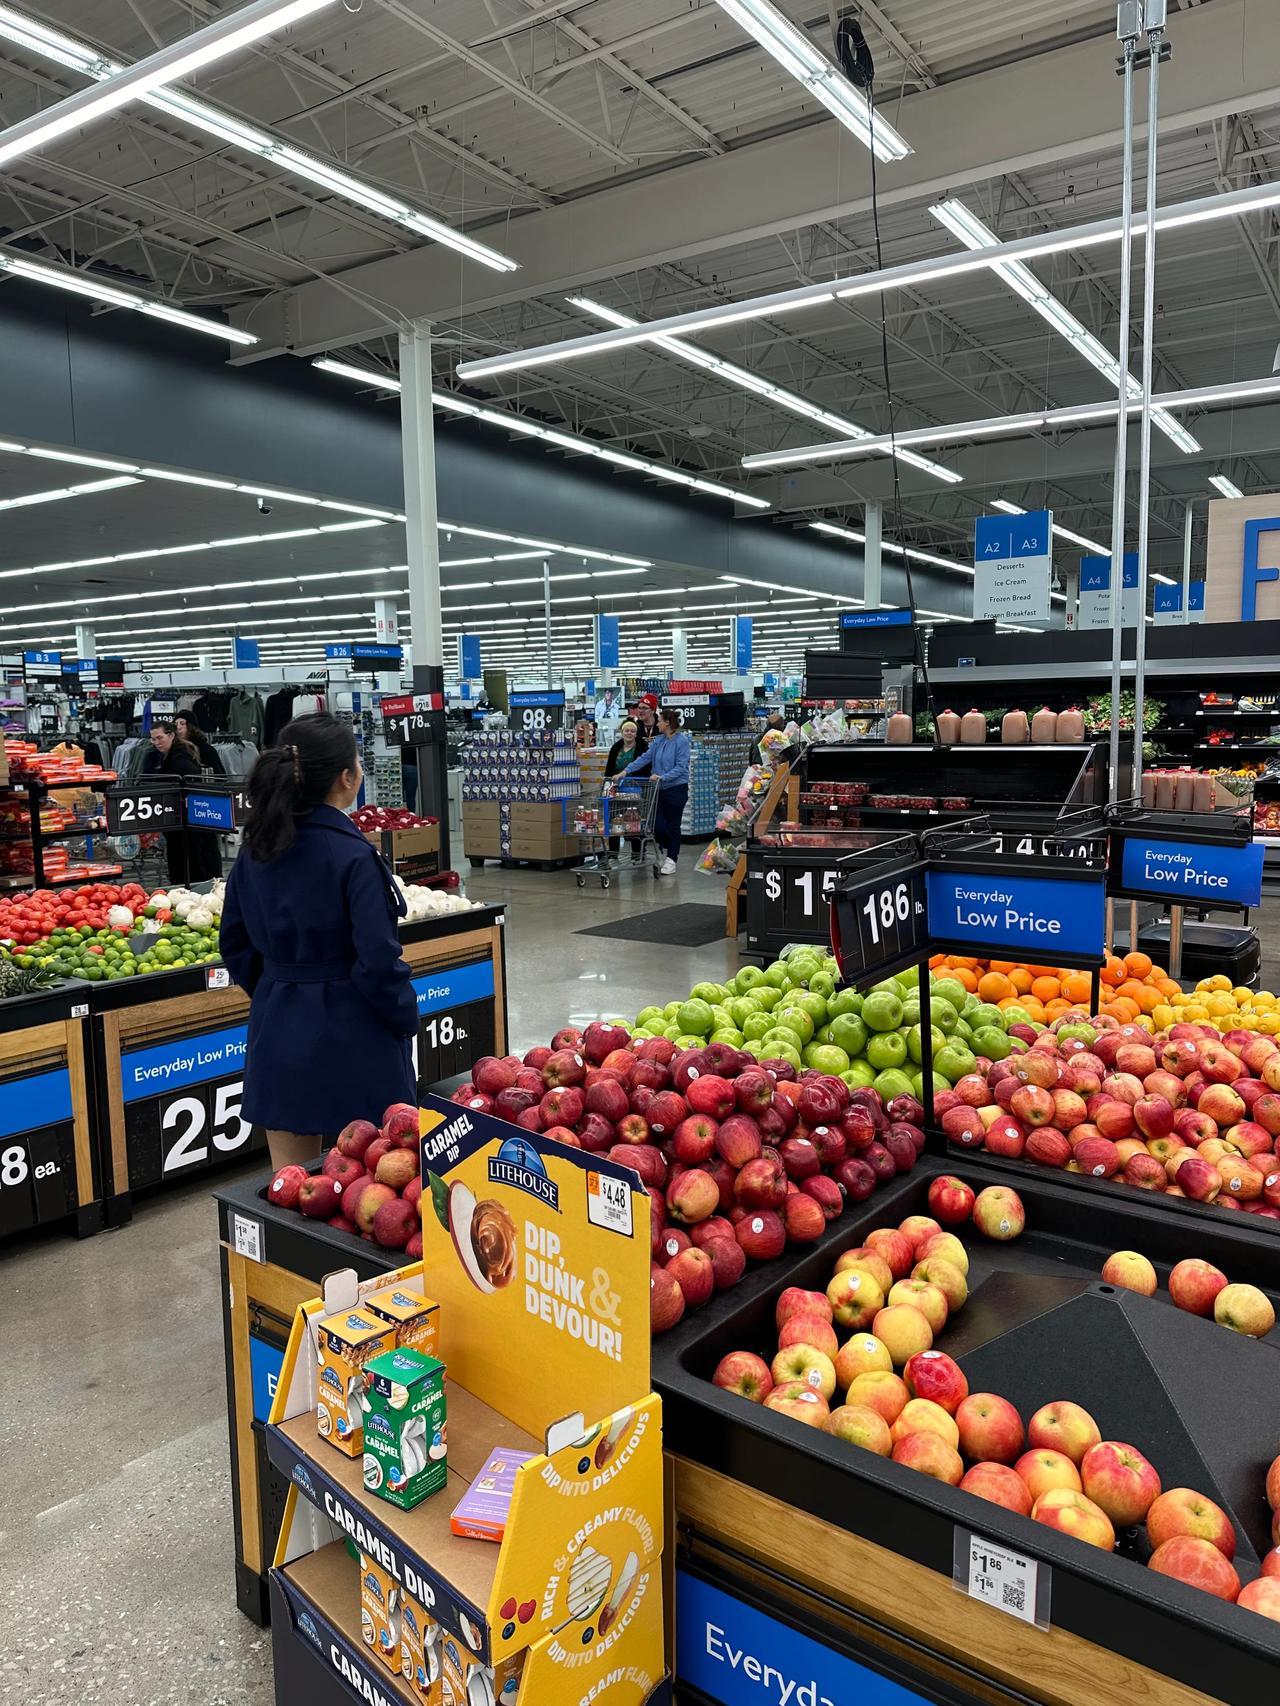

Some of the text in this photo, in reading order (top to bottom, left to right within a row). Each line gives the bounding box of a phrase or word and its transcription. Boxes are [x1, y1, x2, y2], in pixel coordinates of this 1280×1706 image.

[984, 542, 1000, 554] A2
[1021, 538, 1038, 550] A3
[996, 562, 1025, 571] Desserts
[1005, 578, 1027, 586] Cream
[1087, 577, 1101, 585] A4
[1012, 593, 1031, 601] Bread
[1160, 600, 1172, 608] A6
[843, 617, 866, 626] Everyday
[877, 615, 889, 623] Price
[1005, 609, 1037, 617] Breakfast
[35, 653, 49, 663] B 3
[333, 647, 347, 656] B 26
[306, 671, 327, 680] AVIA
[513, 696, 530, 704] Everyday
[537, 695, 548, 703] Price
[194, 809, 222, 821] Low Price
[1145, 849, 1193, 866] Everyday
[1145, 864, 1229, 888] Low Price
[955, 887, 1013, 907] Everyday
[956, 905, 1062, 934] Low Price
[427, 986, 451, 1001] Price
[456, 1027, 468, 1041] lb.
[134, 1040, 248, 1083] Everyday Low Pric
[162, 1080, 253, 1173] 25
[424, 1113, 474, 1162] CARAMEL
[446, 1144, 461, 1163] DIP
[0, 1145, 61, 1186] 8 ea.
[488, 1162, 558, 1207] LITEHOUSE
[603, 1182, 626, 1209] $4.48
[525, 1219, 565, 1270] DIP,
[525, 1252, 622, 1327] DUNK &
[525, 1283, 622, 1363] DEVOUR!
[405, 1326, 436, 1346] CARAMEL
[380, 1378, 386, 1386] 6
[319, 1385, 346, 1411] CARAMEL
[411, 1389, 443, 1414] CARAMEL
[367, 1420, 396, 1441] LITEHOUSE
[364, 1434, 400, 1460] CARAMEL
[540, 1411, 650, 1497] DIP INTO DELICIOUS
[324, 1490, 436, 1609] CARAMEL DIP
[540, 1505, 655, 1621] RICH & CREAMY FLAVOR!
[546, 1571, 650, 1669] DIP INTO DELICIOUS
[330, 1643, 392, 1706] CARAM
[579, 1666, 626, 1706] REAMY
